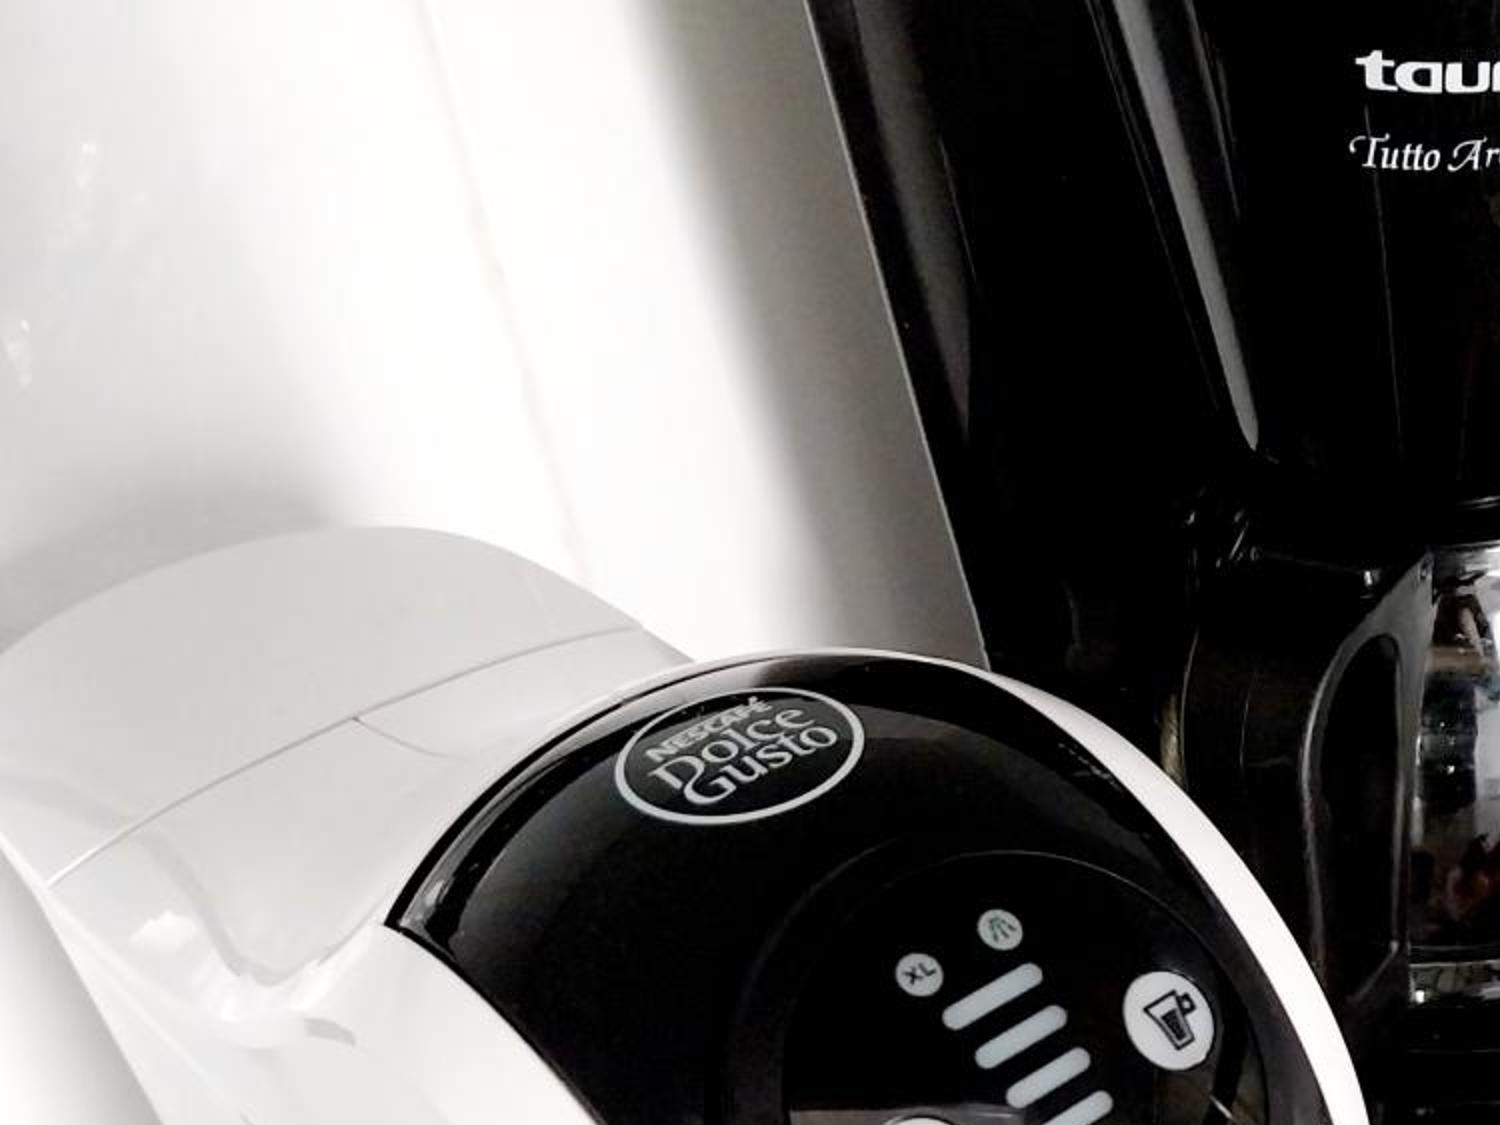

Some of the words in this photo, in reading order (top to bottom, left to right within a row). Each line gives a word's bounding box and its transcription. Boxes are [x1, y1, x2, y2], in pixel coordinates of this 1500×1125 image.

[1348, 132, 1442, 172] Tutto
[647, 708, 816, 791] Dolce
[683, 726, 838, 806] Gusto
[903, 962, 937, 987] XL
